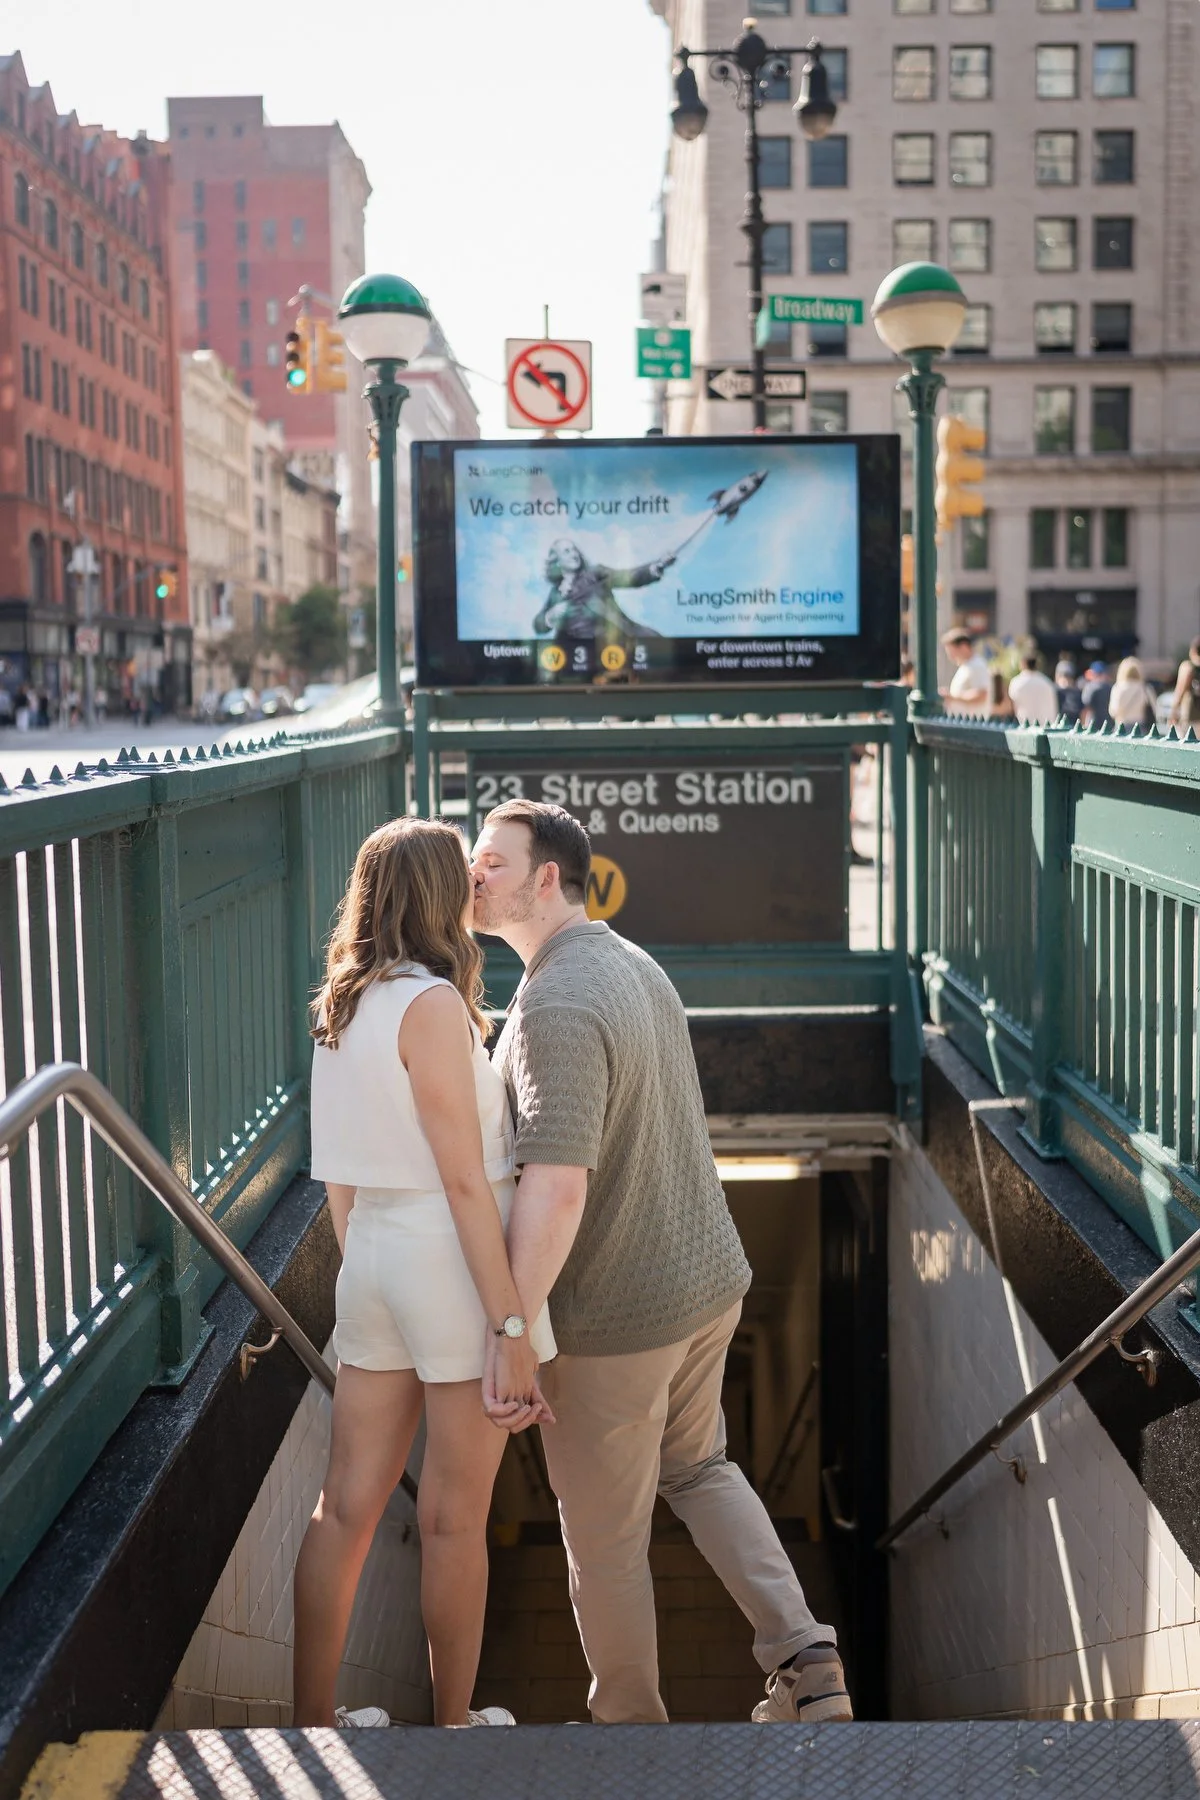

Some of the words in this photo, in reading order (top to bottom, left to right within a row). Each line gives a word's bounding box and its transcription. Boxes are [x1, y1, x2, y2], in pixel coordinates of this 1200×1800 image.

[773, 298, 855, 322] Broadway
[764, 377, 792, 392] WAY
[482, 465, 543, 478] LangChain
[470, 498, 504, 517] We
[510, 497, 569, 516] catch
[575, 499, 622, 519] your
[627, 495, 670, 514] drift
[677, 587, 776, 609] LangSmith
[780, 586, 844, 608] Engine
[686, 614, 703, 622] The
[706, 613, 735, 624] Agent
[737, 613, 751, 622] for
[754, 613, 783, 624] Agent
[786, 611, 844, 622] Engineering
[483, 645, 530, 658] Uptown
[573, 647, 587, 663] 3
[634, 645, 647, 662] 5
[696, 640, 717, 653] For
[719, 640, 783, 653] downtown
[785, 640, 825, 653] trains,
[707, 656, 740, 668] enter
[742, 656, 784, 667] across
[796, 655, 813, 667] Av
[476, 775, 523, 807] 23
[541, 774, 658, 806] Street
[675, 771, 812, 804] Station
[589, 810, 607, 833] &
[619, 809, 720, 833] Queens
